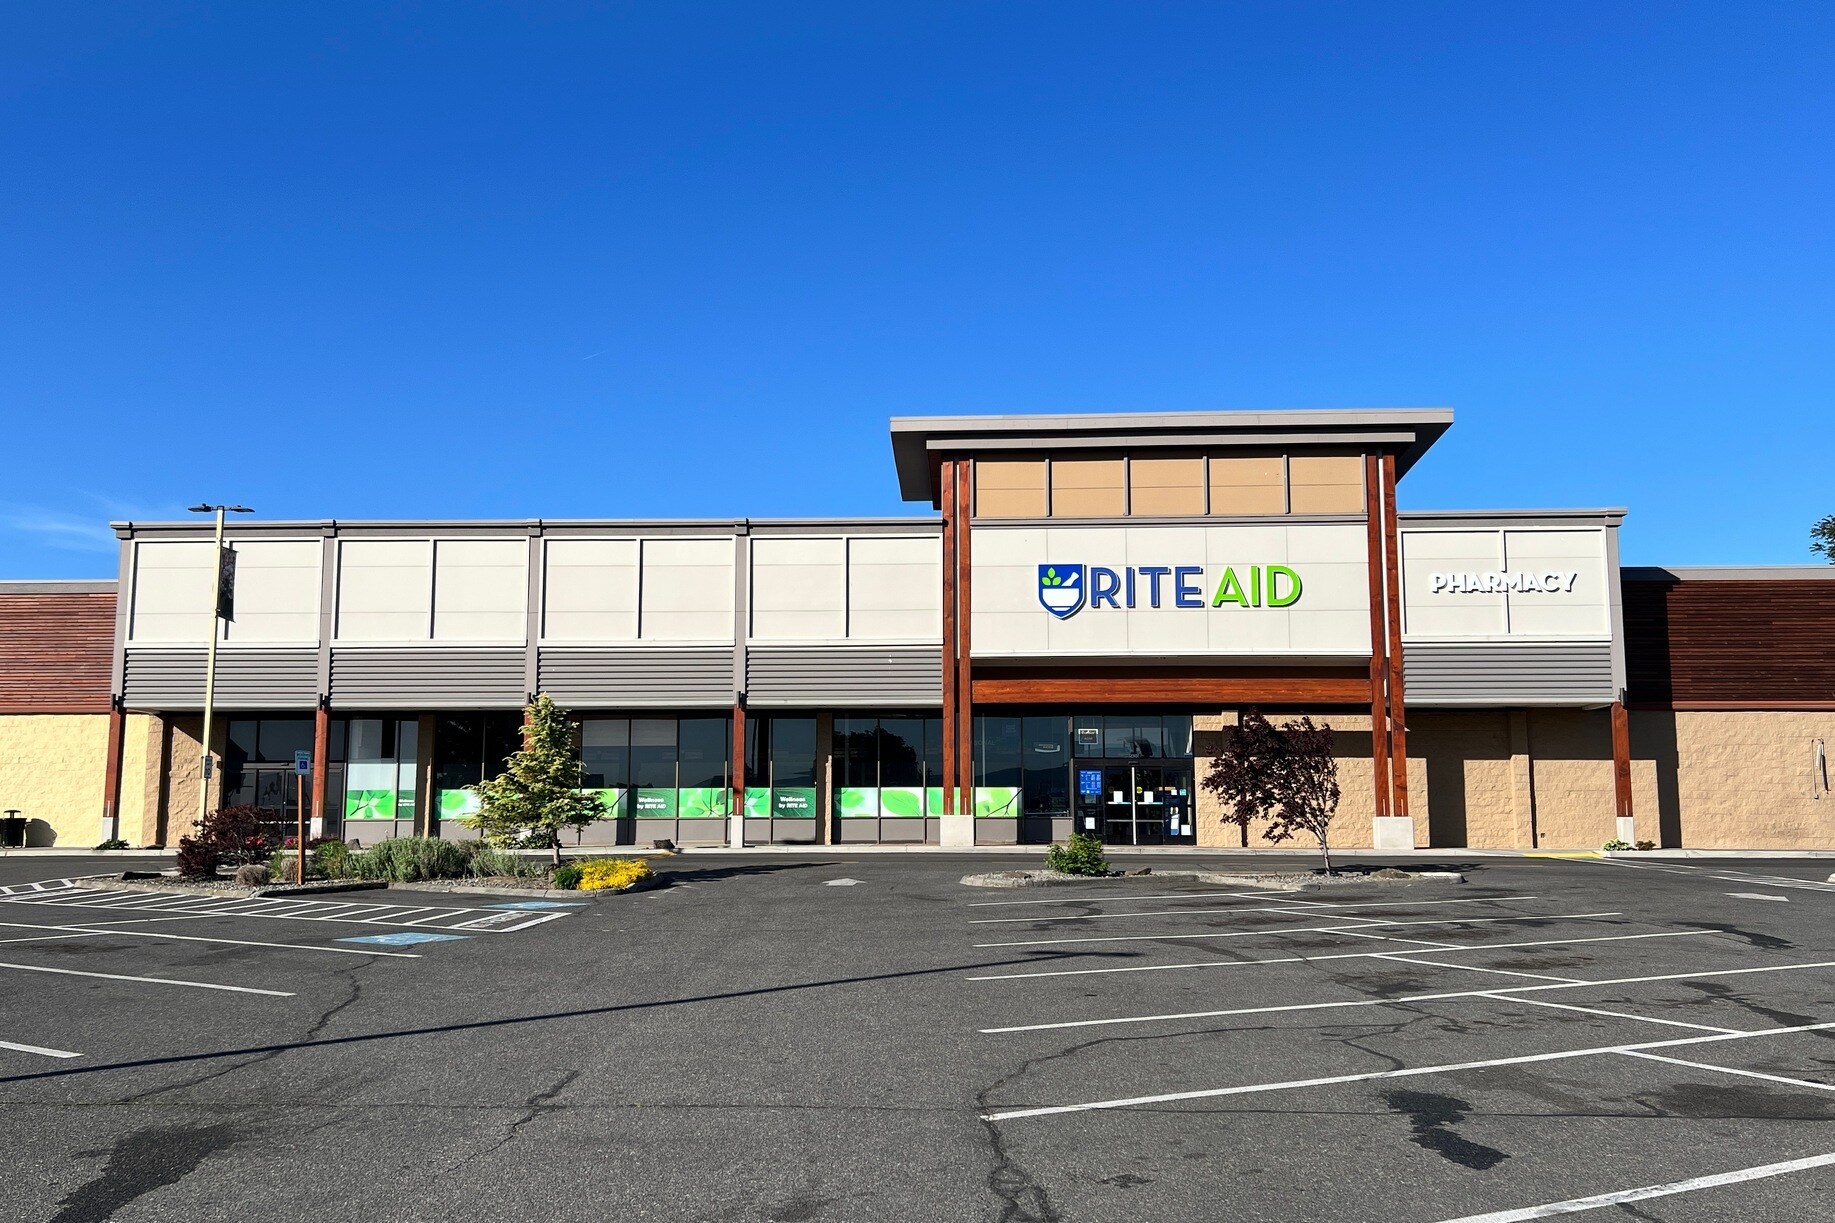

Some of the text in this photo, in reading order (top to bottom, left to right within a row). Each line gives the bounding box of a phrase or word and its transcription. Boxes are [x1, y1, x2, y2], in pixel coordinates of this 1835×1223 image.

[1090, 565, 1303, 608] RITE AID
[1428, 571, 1578, 594] PHARMACY
